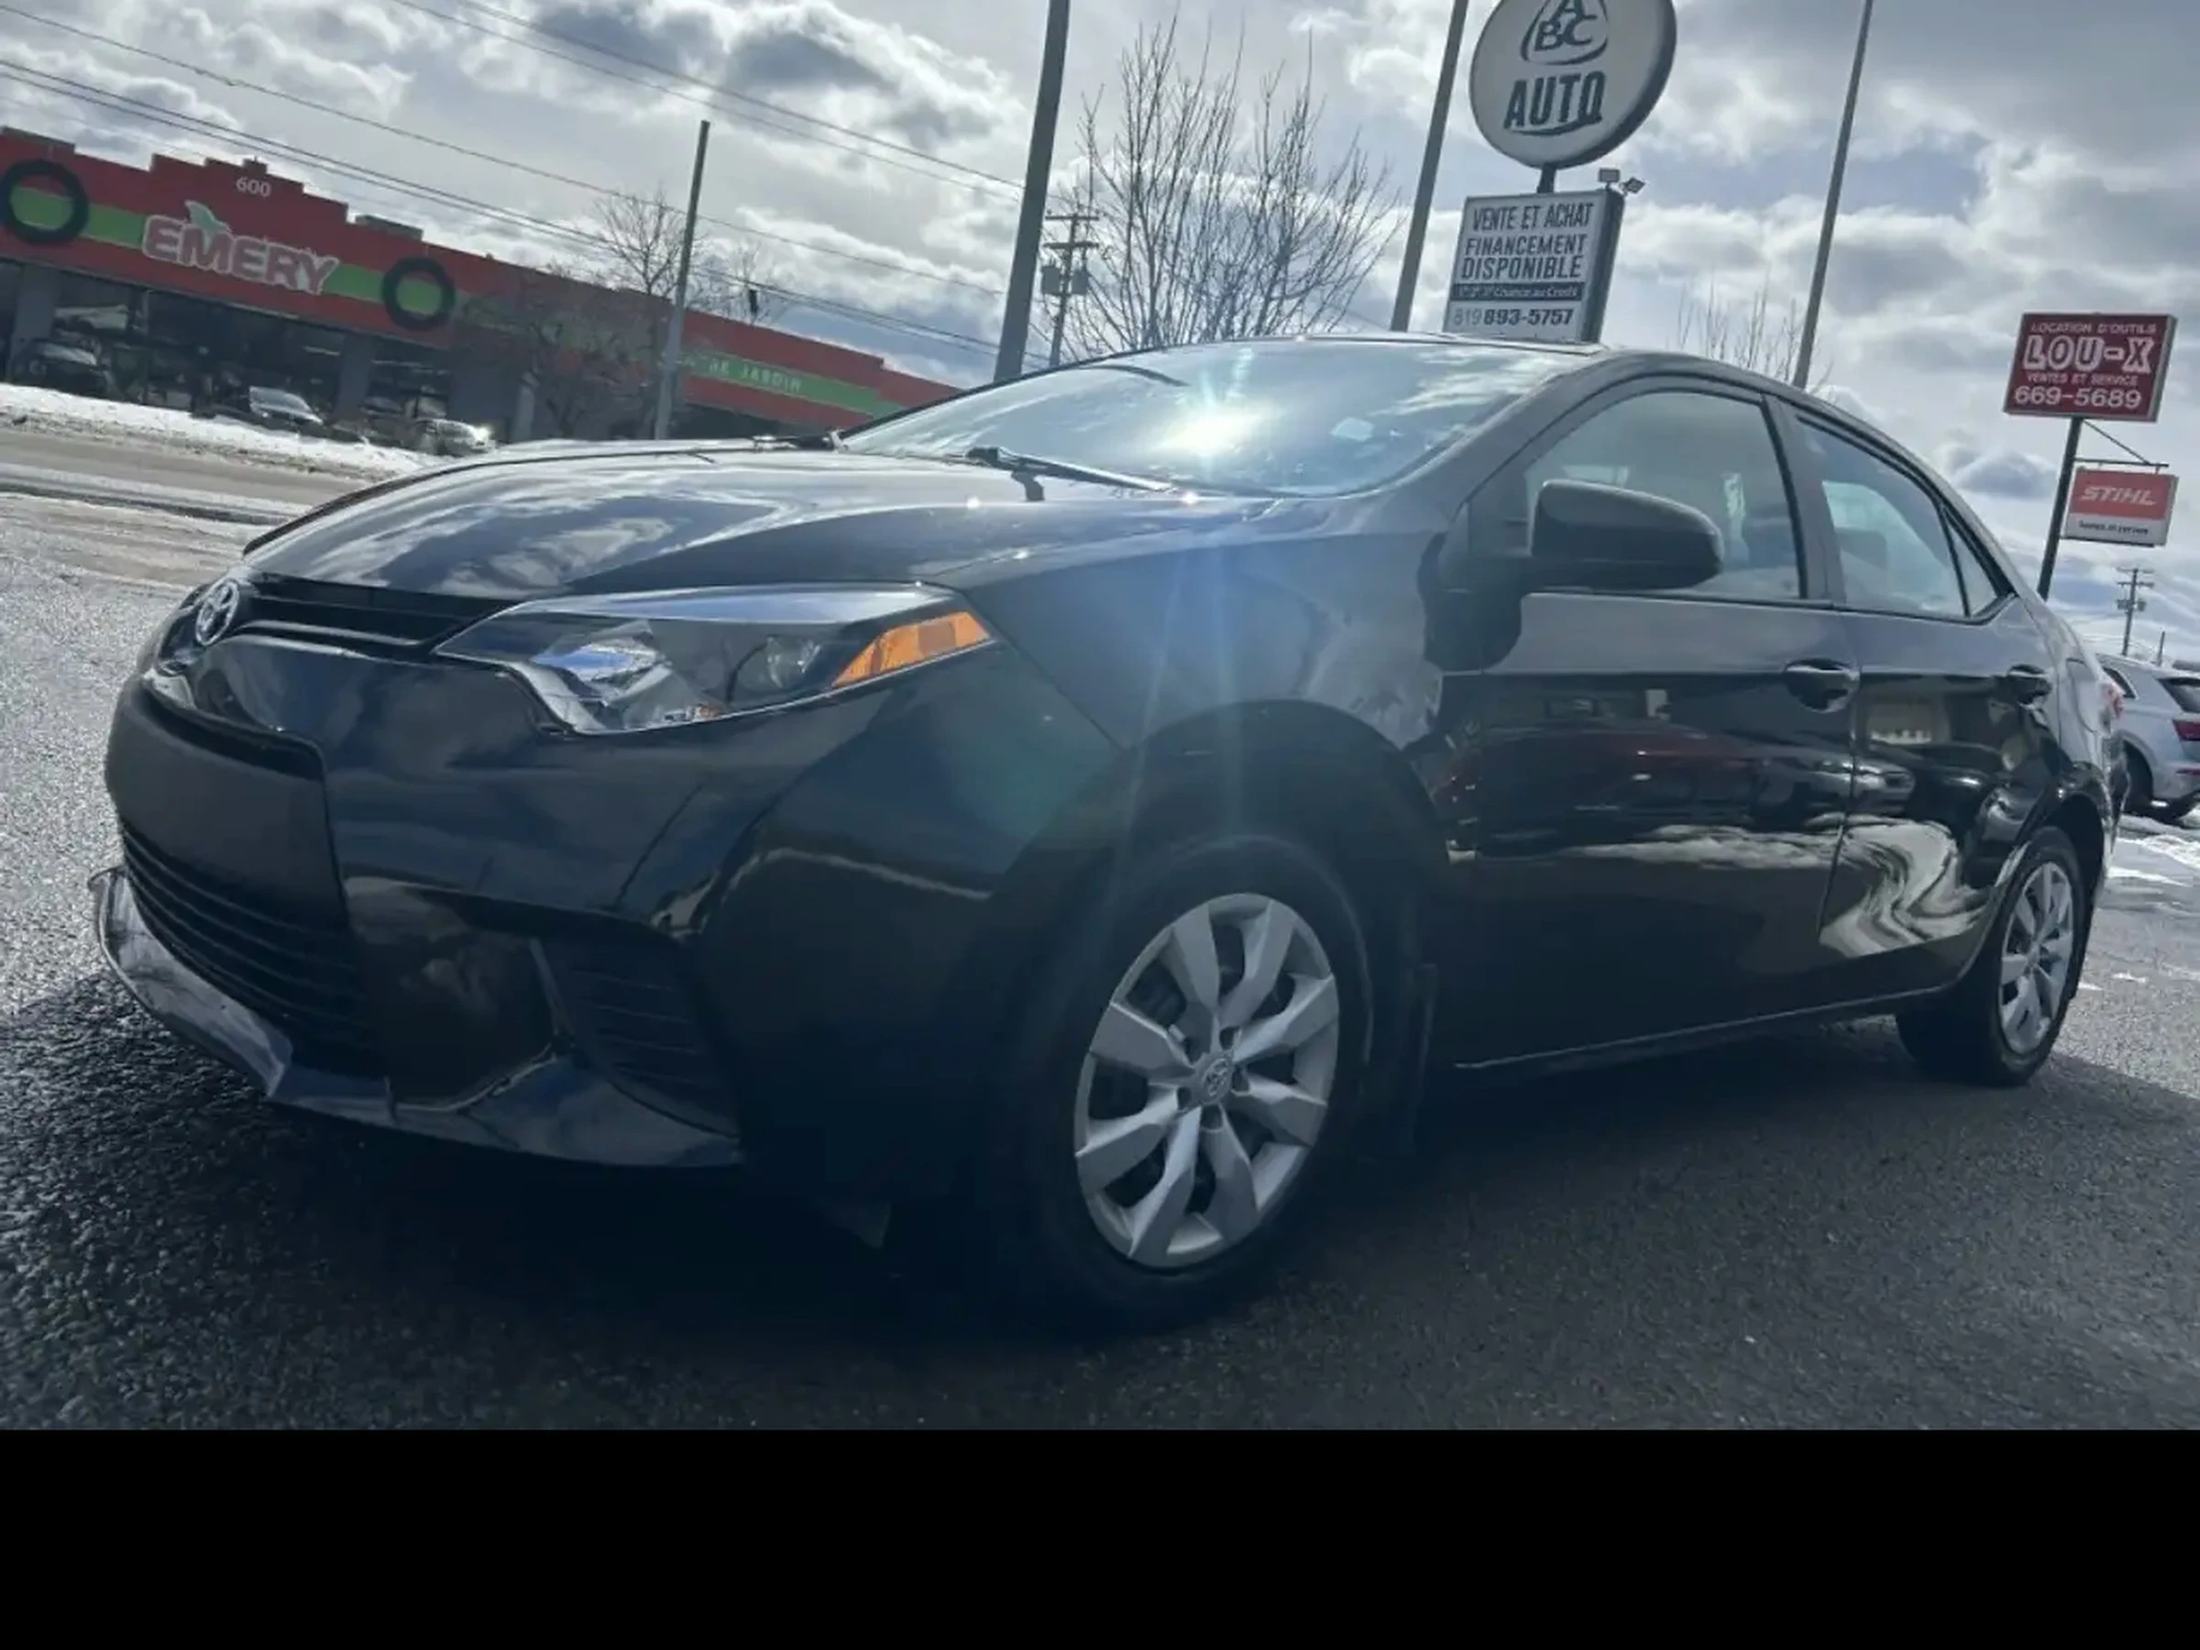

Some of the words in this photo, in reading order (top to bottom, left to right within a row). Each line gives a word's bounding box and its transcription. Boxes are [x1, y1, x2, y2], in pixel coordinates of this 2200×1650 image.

[1503, 71, 1606, 130] AUTO
[236, 176, 271, 198] 600
[1472, 206, 1515, 232] VENTE
[1520, 205, 1541, 230] ET
[1543, 203, 1594, 229] ACHAT
[142, 214, 340, 295] EMERY
[1465, 233, 1588, 256] FINANCEMENT
[1461, 255, 1584, 280] DISPONIBLE
[2031, 321, 2093, 334] LOCATION
[2022, 334, 2155, 374] LOU-X
[2015, 385, 2142, 409] 669-5689
[2080, 485, 2157, 506] STIHL
